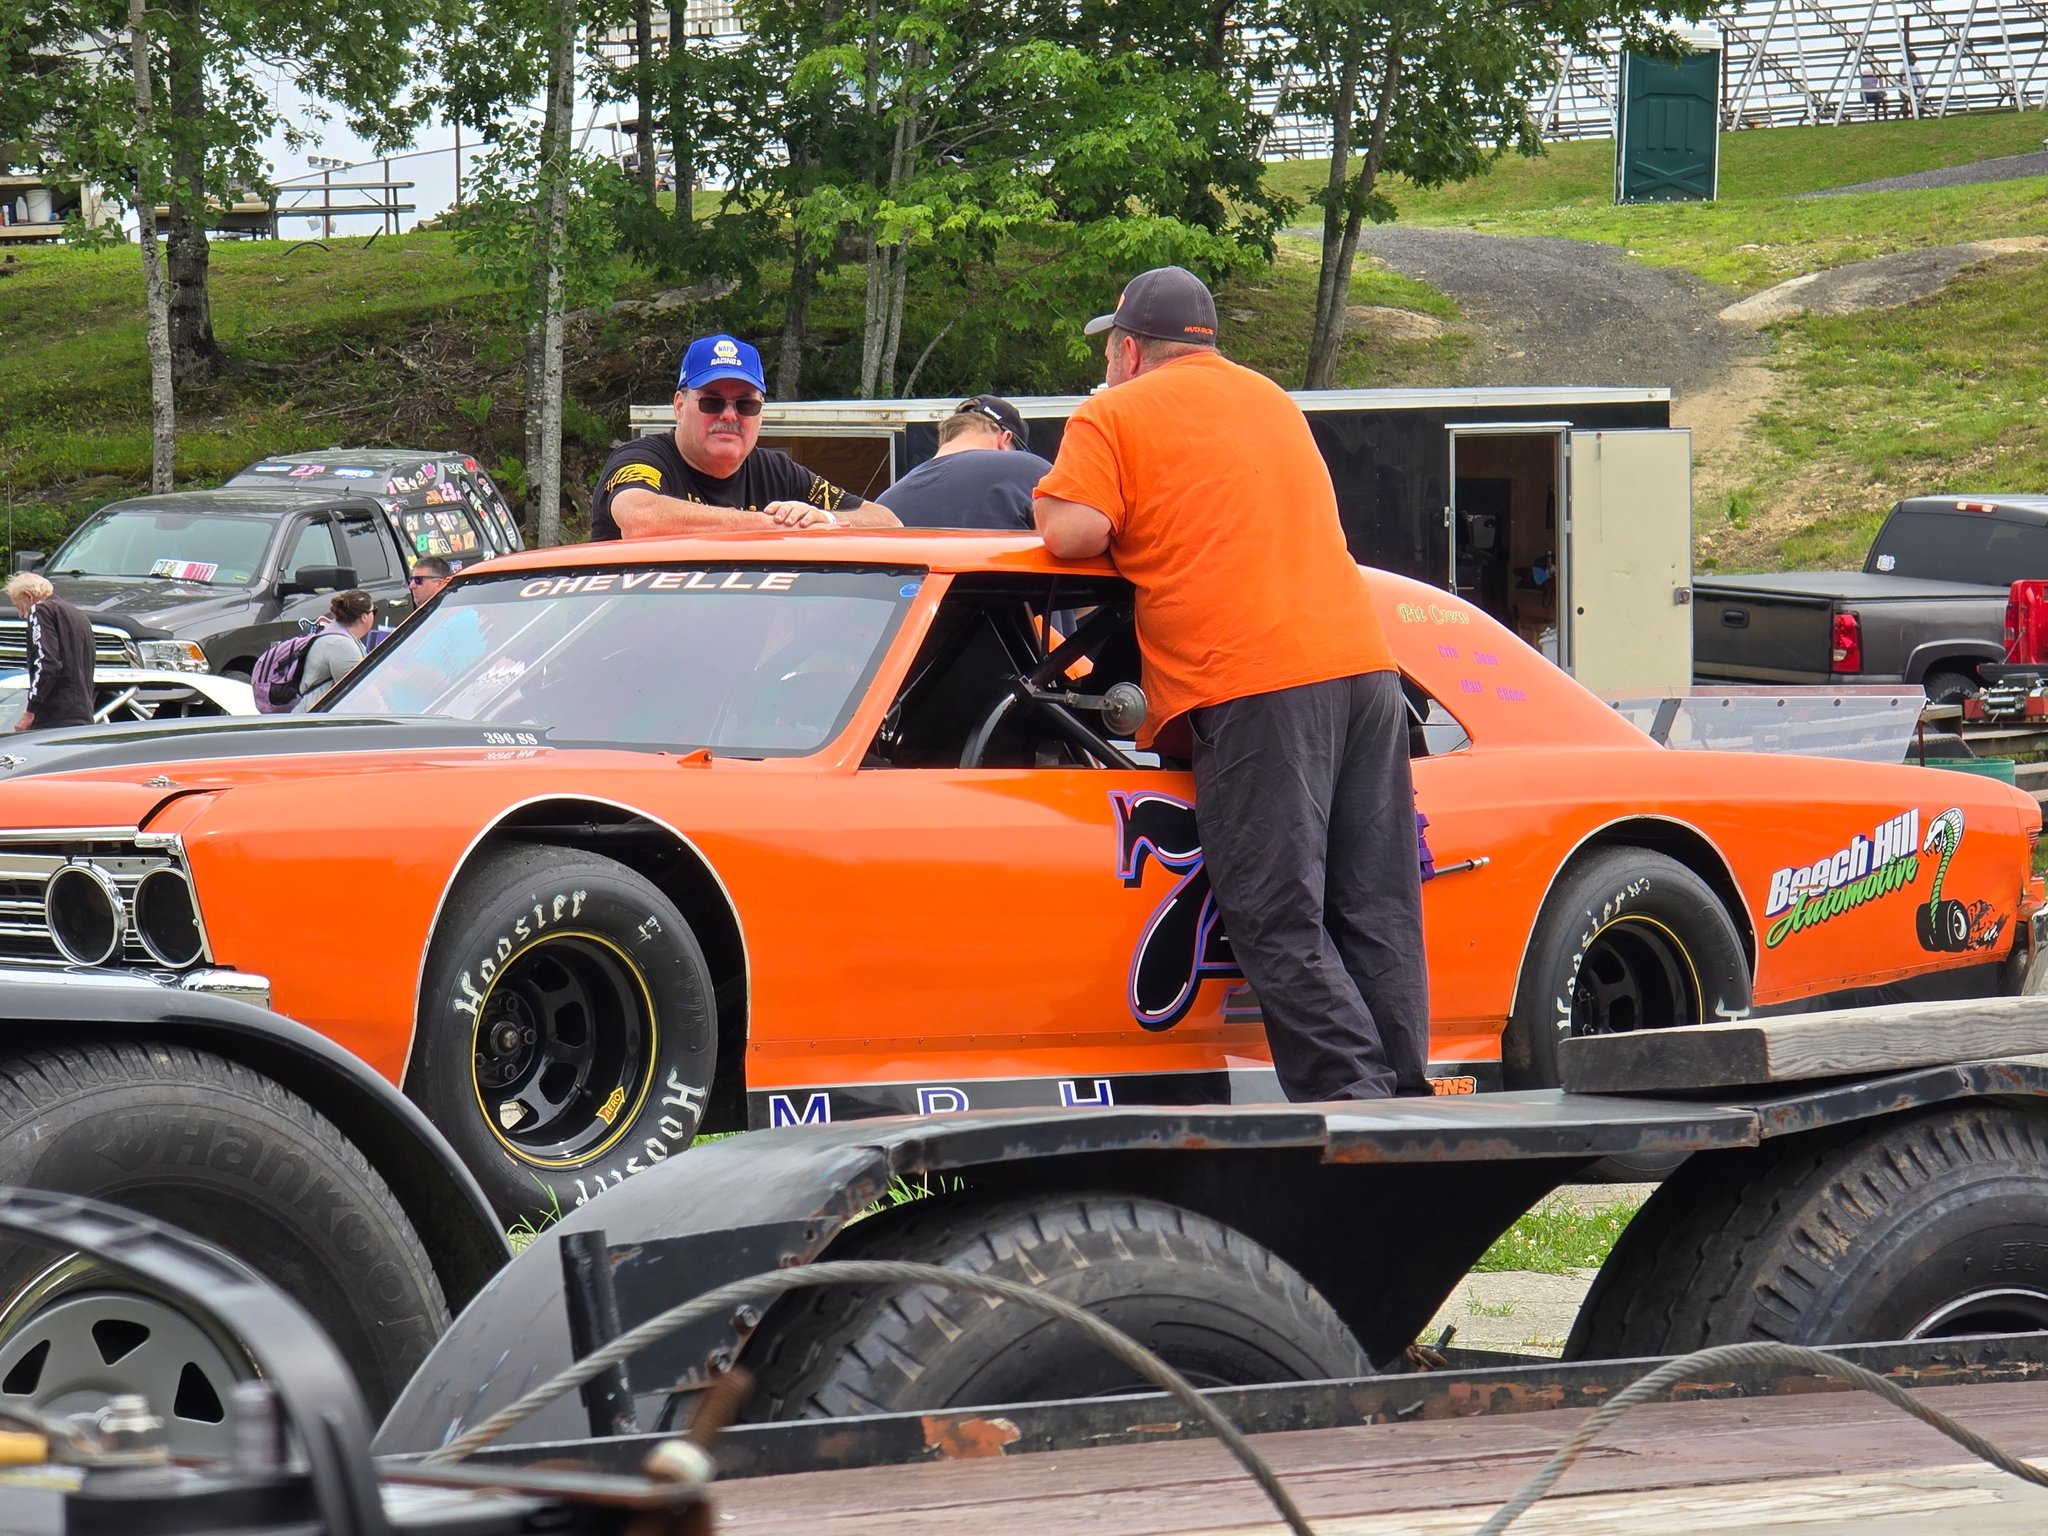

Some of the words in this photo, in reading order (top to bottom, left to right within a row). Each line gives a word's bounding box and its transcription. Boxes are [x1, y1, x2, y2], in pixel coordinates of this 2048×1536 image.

[519, 572, 800, 598] CHEVELLE
[1398, 603, 1427, 623] Pit
[1428, 604, 1470, 625] Crew
[483, 732, 515, 744] 396
[516, 733, 537, 745] SS
[1765, 834, 1873, 917] Beech
[1872, 807, 1919, 872] Hill
[1765, 855, 1920, 948] Automotive
[453, 890, 588, 1018] Hoosier
[606, 1093, 622, 1117] AERO
